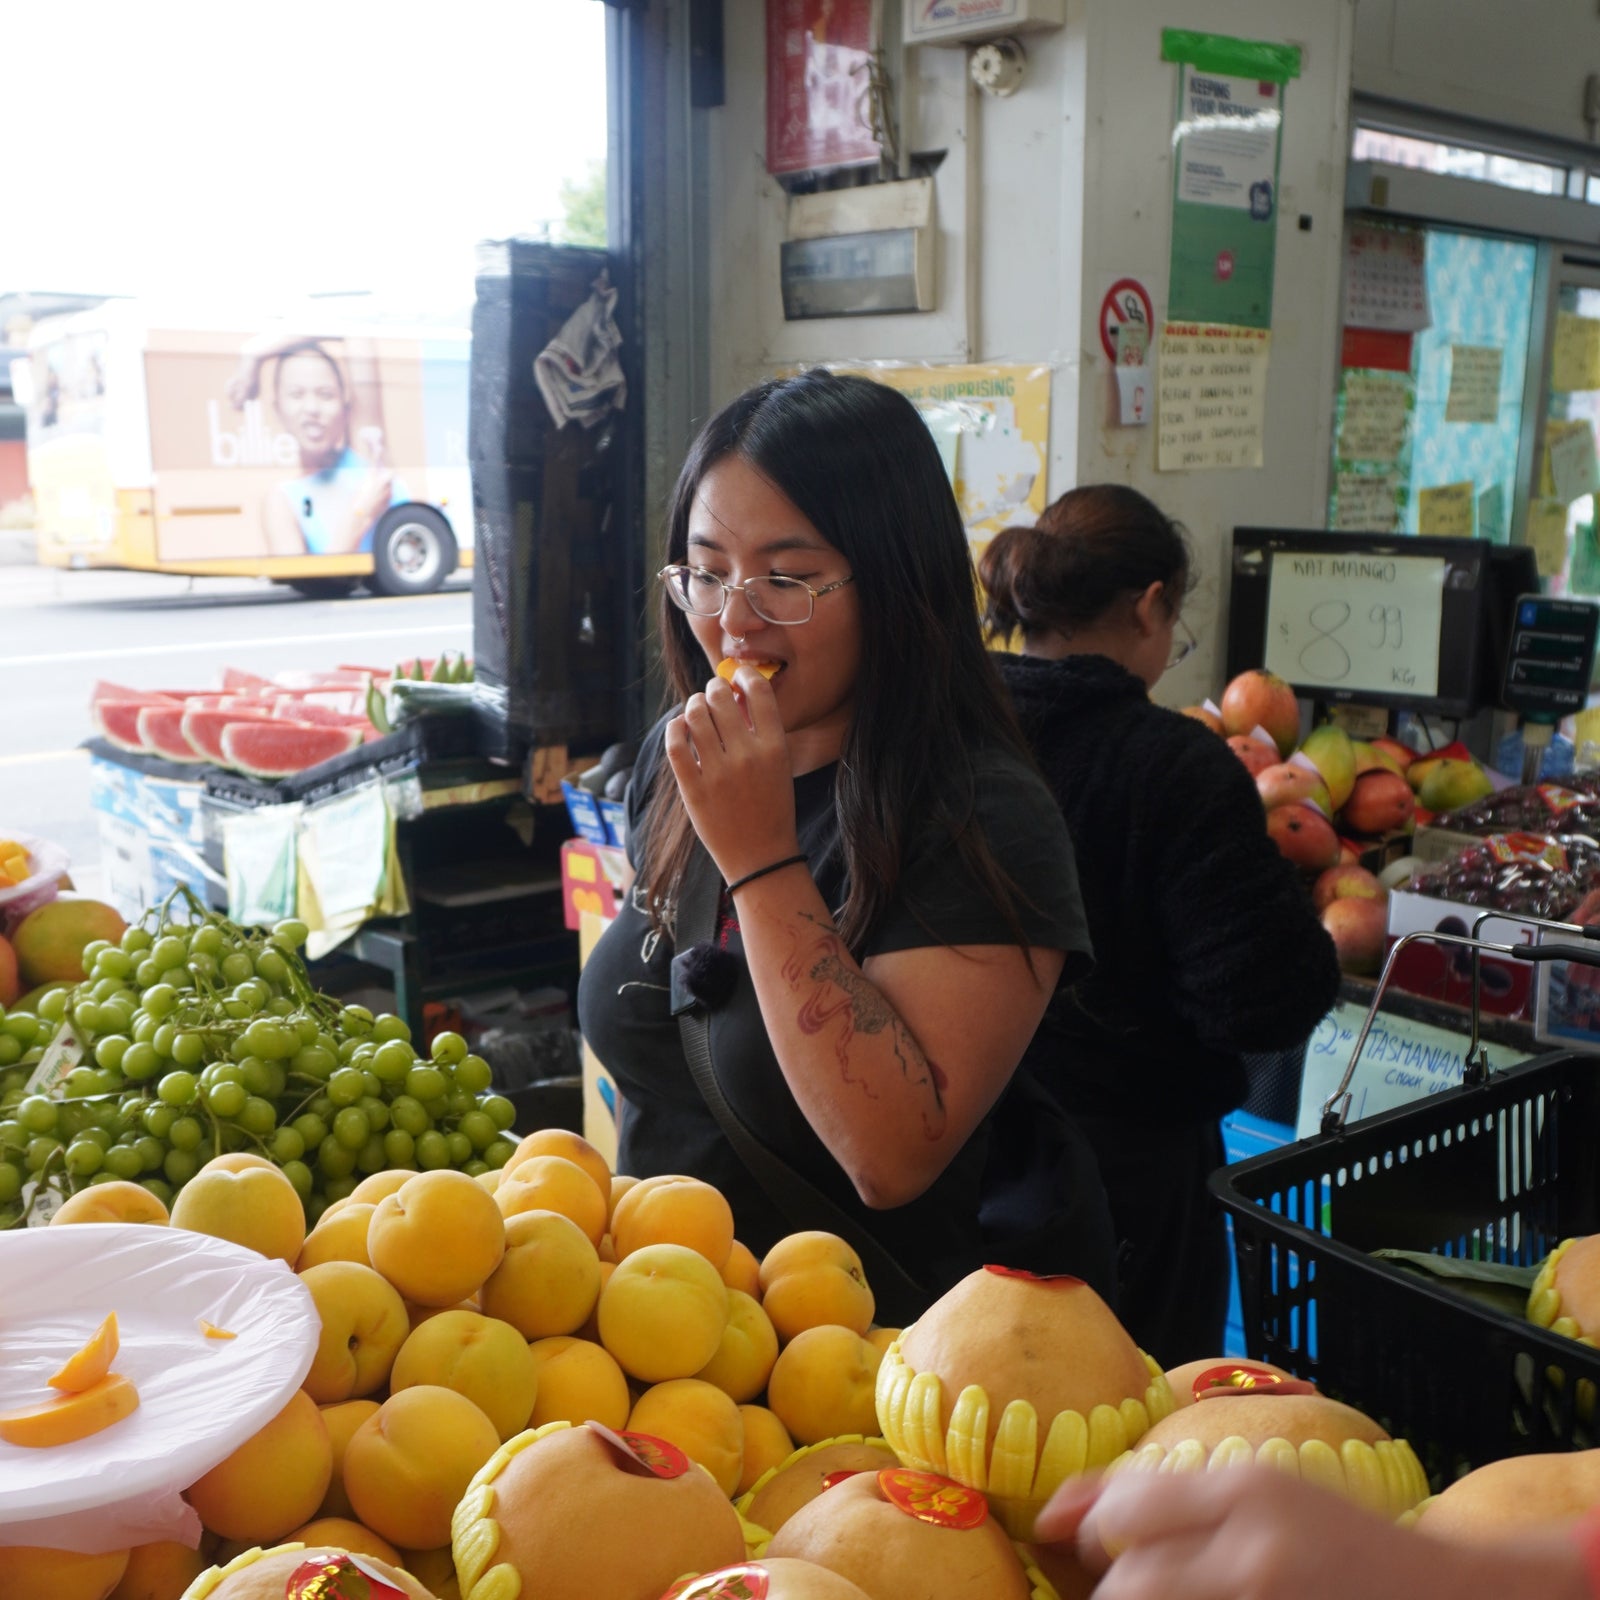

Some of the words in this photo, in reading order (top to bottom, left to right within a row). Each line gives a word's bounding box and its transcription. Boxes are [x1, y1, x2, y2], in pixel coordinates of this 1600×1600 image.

[1190, 77, 1231, 100] KEEPING
[928, 375, 1016, 402] SURPRISING
[208, 399, 300, 467] billie
[1332, 559, 1397, 583] MANGO
[1298, 598, 1351, 682] 8
[1369, 602, 1404, 649] 99
[1366, 1027, 1466, 1081] TASMANIAN
